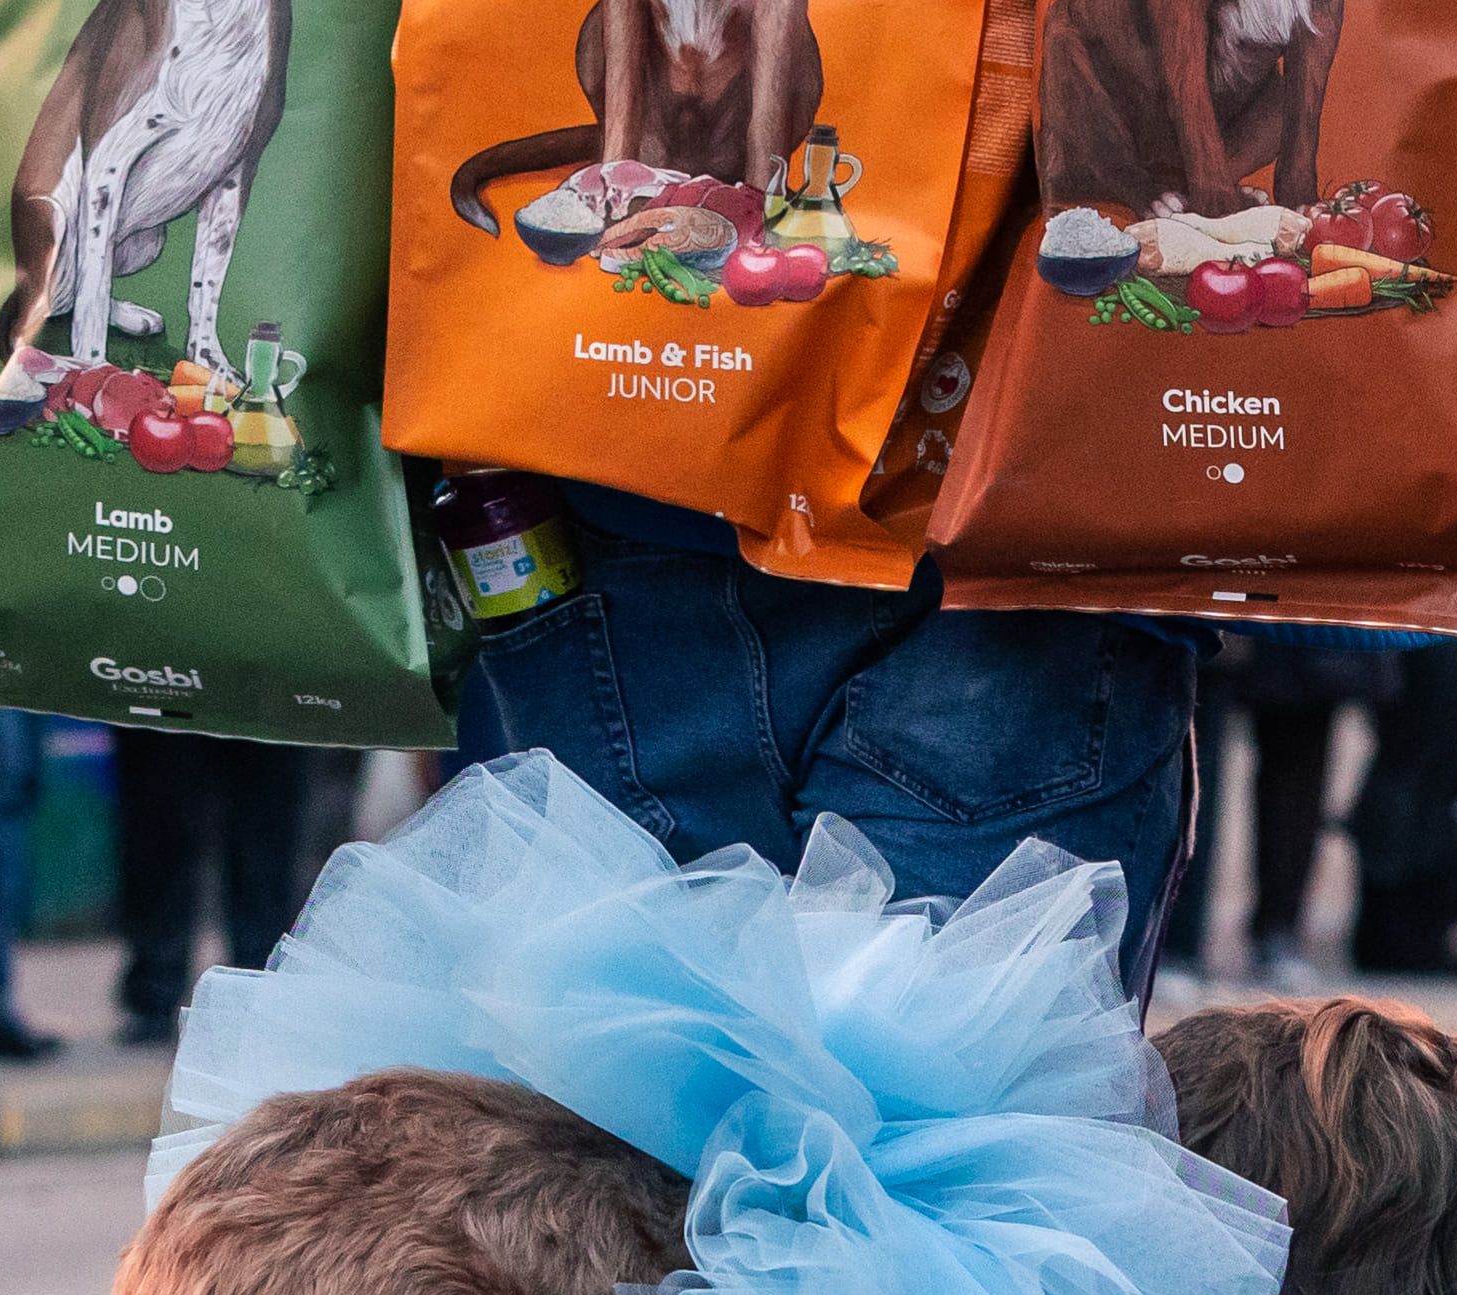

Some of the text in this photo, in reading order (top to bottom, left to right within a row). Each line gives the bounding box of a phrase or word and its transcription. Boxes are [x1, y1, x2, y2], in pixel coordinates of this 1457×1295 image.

[574, 333, 753, 371] Lamb & Fish
[607, 373, 717, 404] JUNIOR
[1162, 388, 1281, 415] Chicken
[1162, 423, 1285, 450] MEDIUM
[95, 501, 173, 534] Lamb
[68, 532, 200, 572] MEDIUM
[89, 656, 203, 691] Gosbi
[294, 694, 342, 711] 12kg
